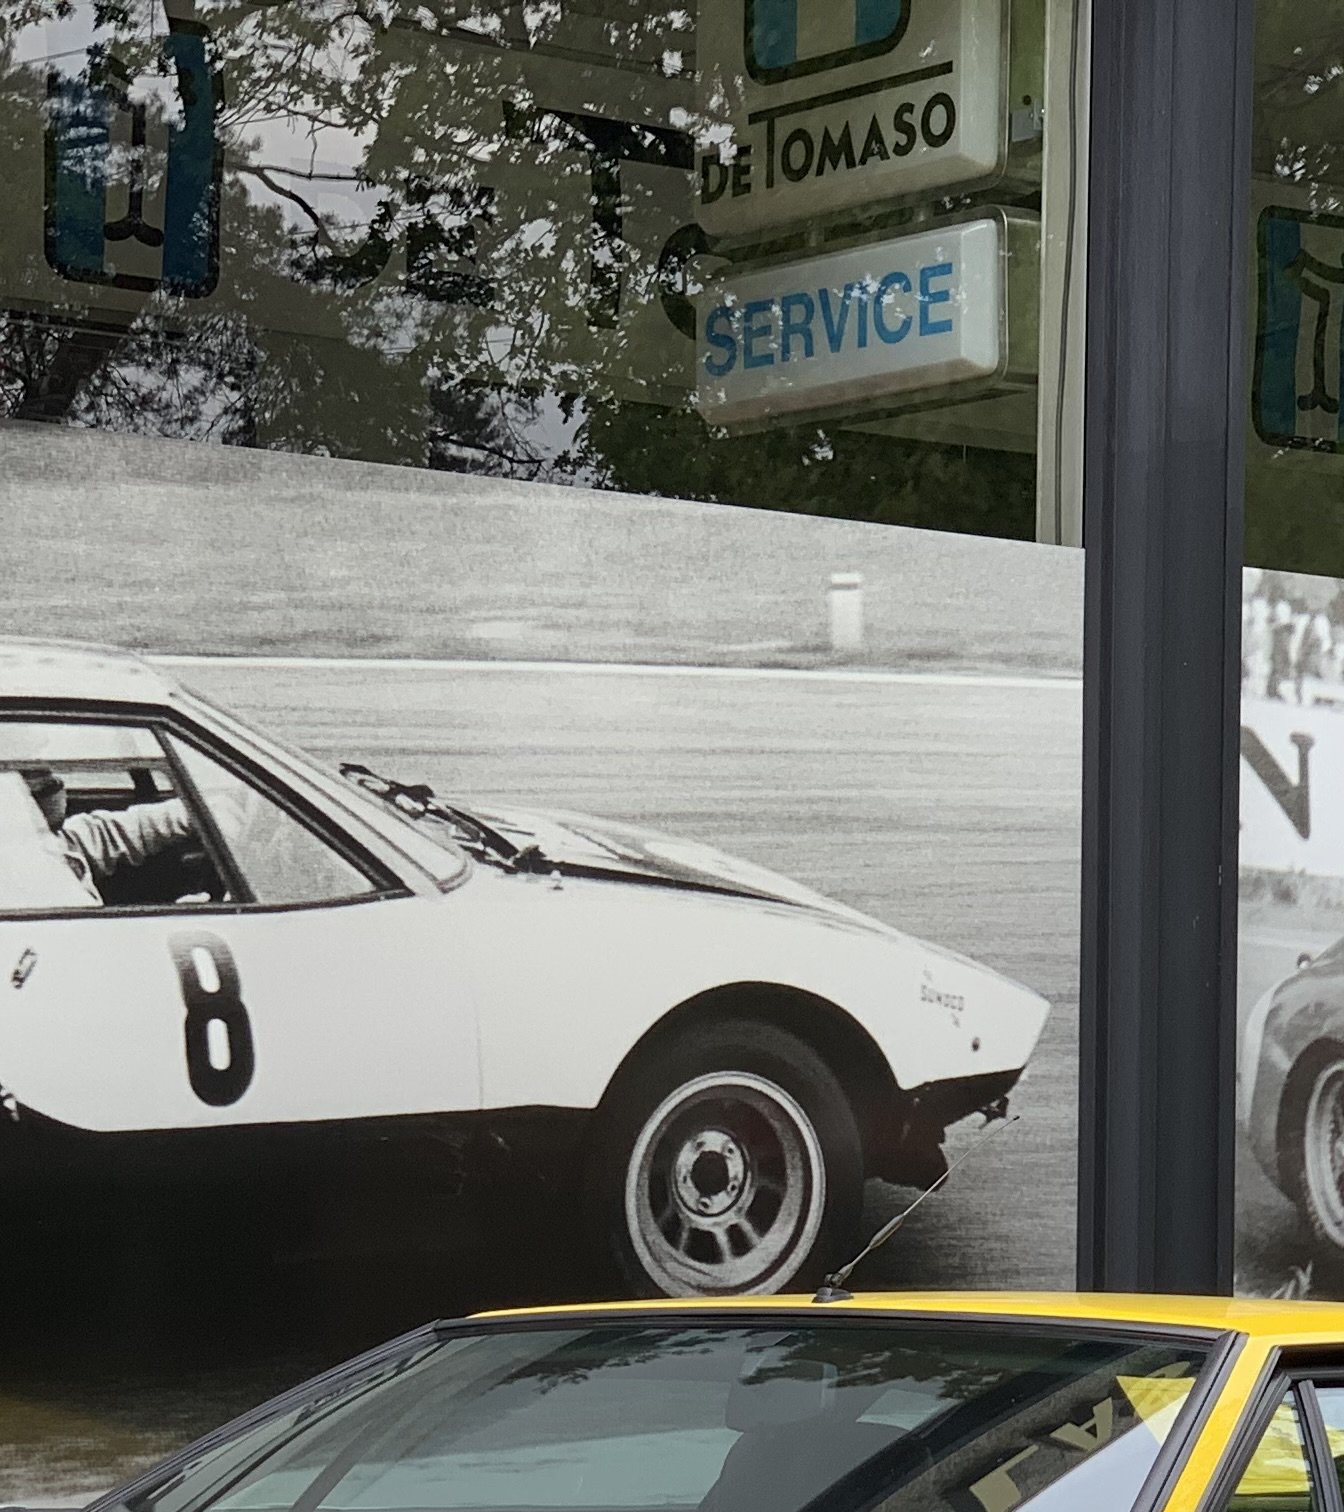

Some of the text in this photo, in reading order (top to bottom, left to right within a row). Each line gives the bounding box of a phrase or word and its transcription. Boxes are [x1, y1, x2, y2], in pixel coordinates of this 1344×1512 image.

[700, 60, 956, 205] DE TOMASO
[704, 261, 954, 377] SERVICE
[167, 928, 256, 1107] 8
